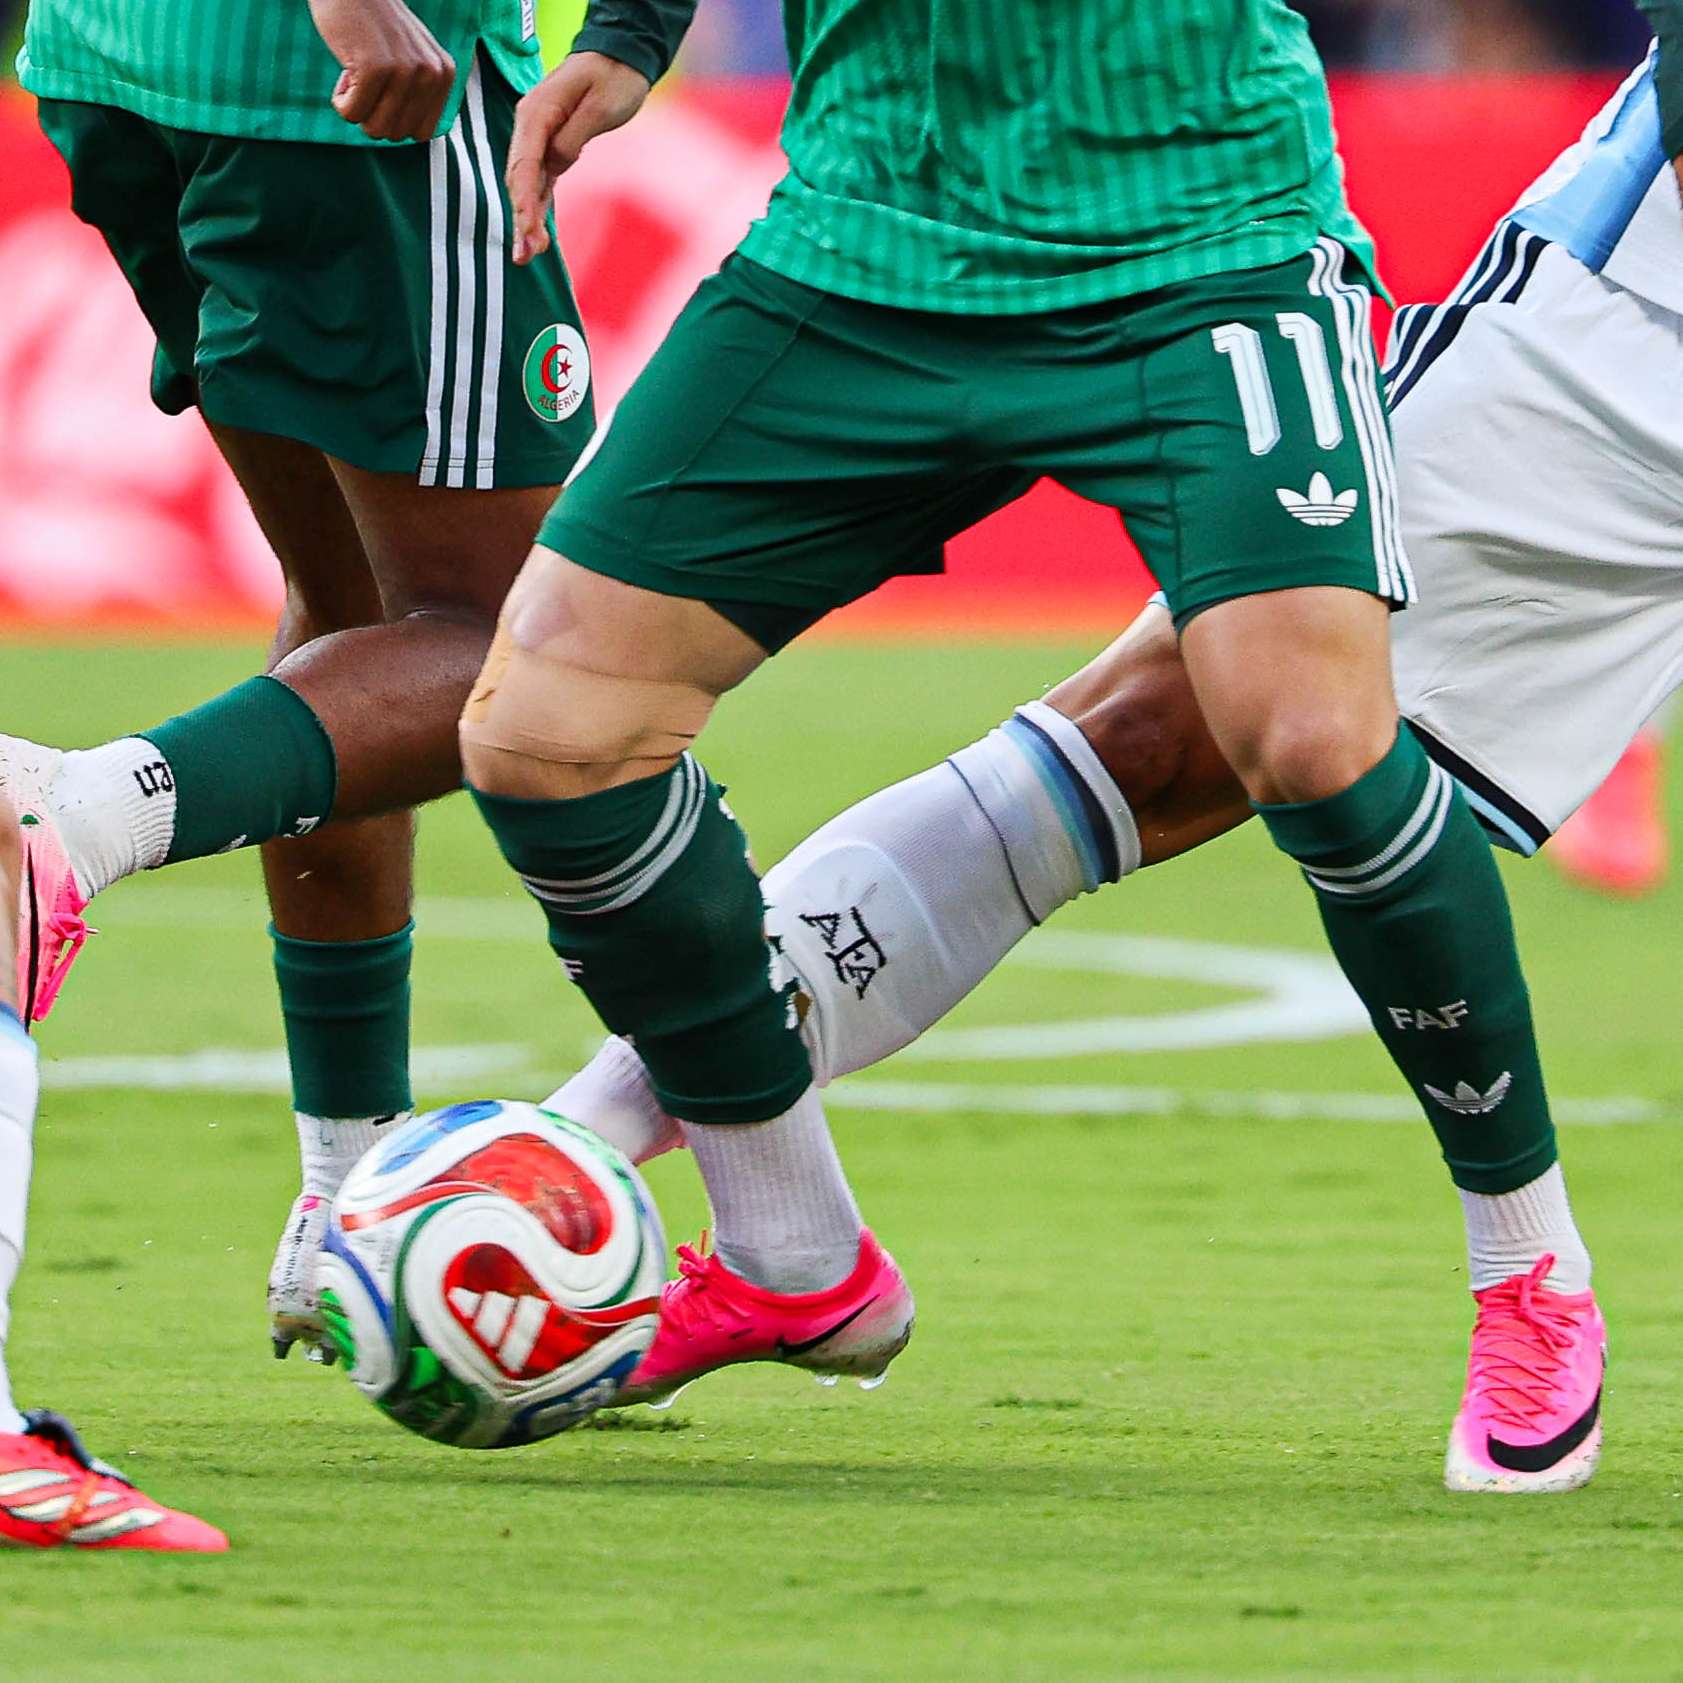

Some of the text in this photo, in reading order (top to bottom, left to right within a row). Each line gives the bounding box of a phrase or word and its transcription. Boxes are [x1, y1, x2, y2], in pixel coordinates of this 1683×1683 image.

[539, 390, 579, 411] ALGERIA
[1210, 311, 1344, 456] 11
[798, 906, 887, 1000] AFA
[1387, 999, 1470, 1030] FAF
